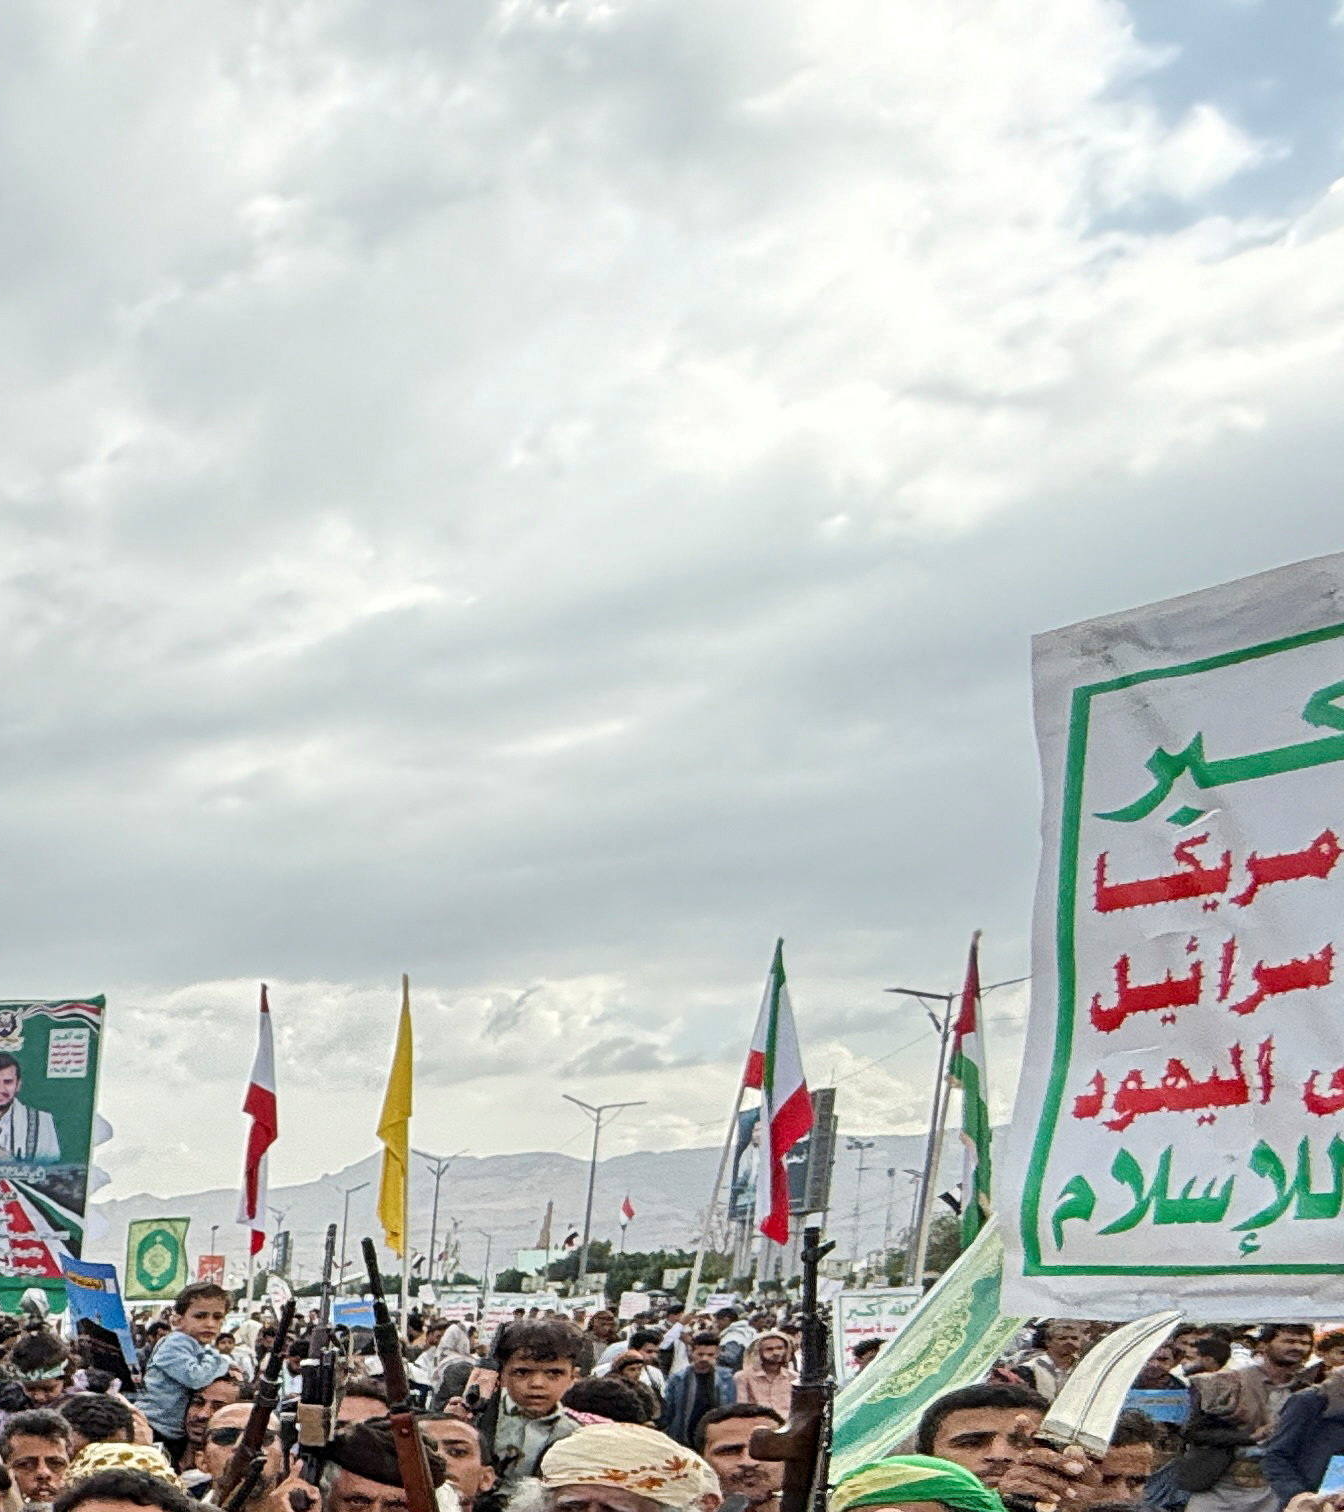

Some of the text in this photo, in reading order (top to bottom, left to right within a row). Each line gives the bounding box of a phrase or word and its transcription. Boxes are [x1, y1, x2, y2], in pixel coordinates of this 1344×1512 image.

[1092, 680, 1344, 827] كبر
[1092, 828, 1344, 914] مريكا
[1090, 936, 1335, 1034] سرائيل
[1072, 1035, 1275, 1133] اليهود
